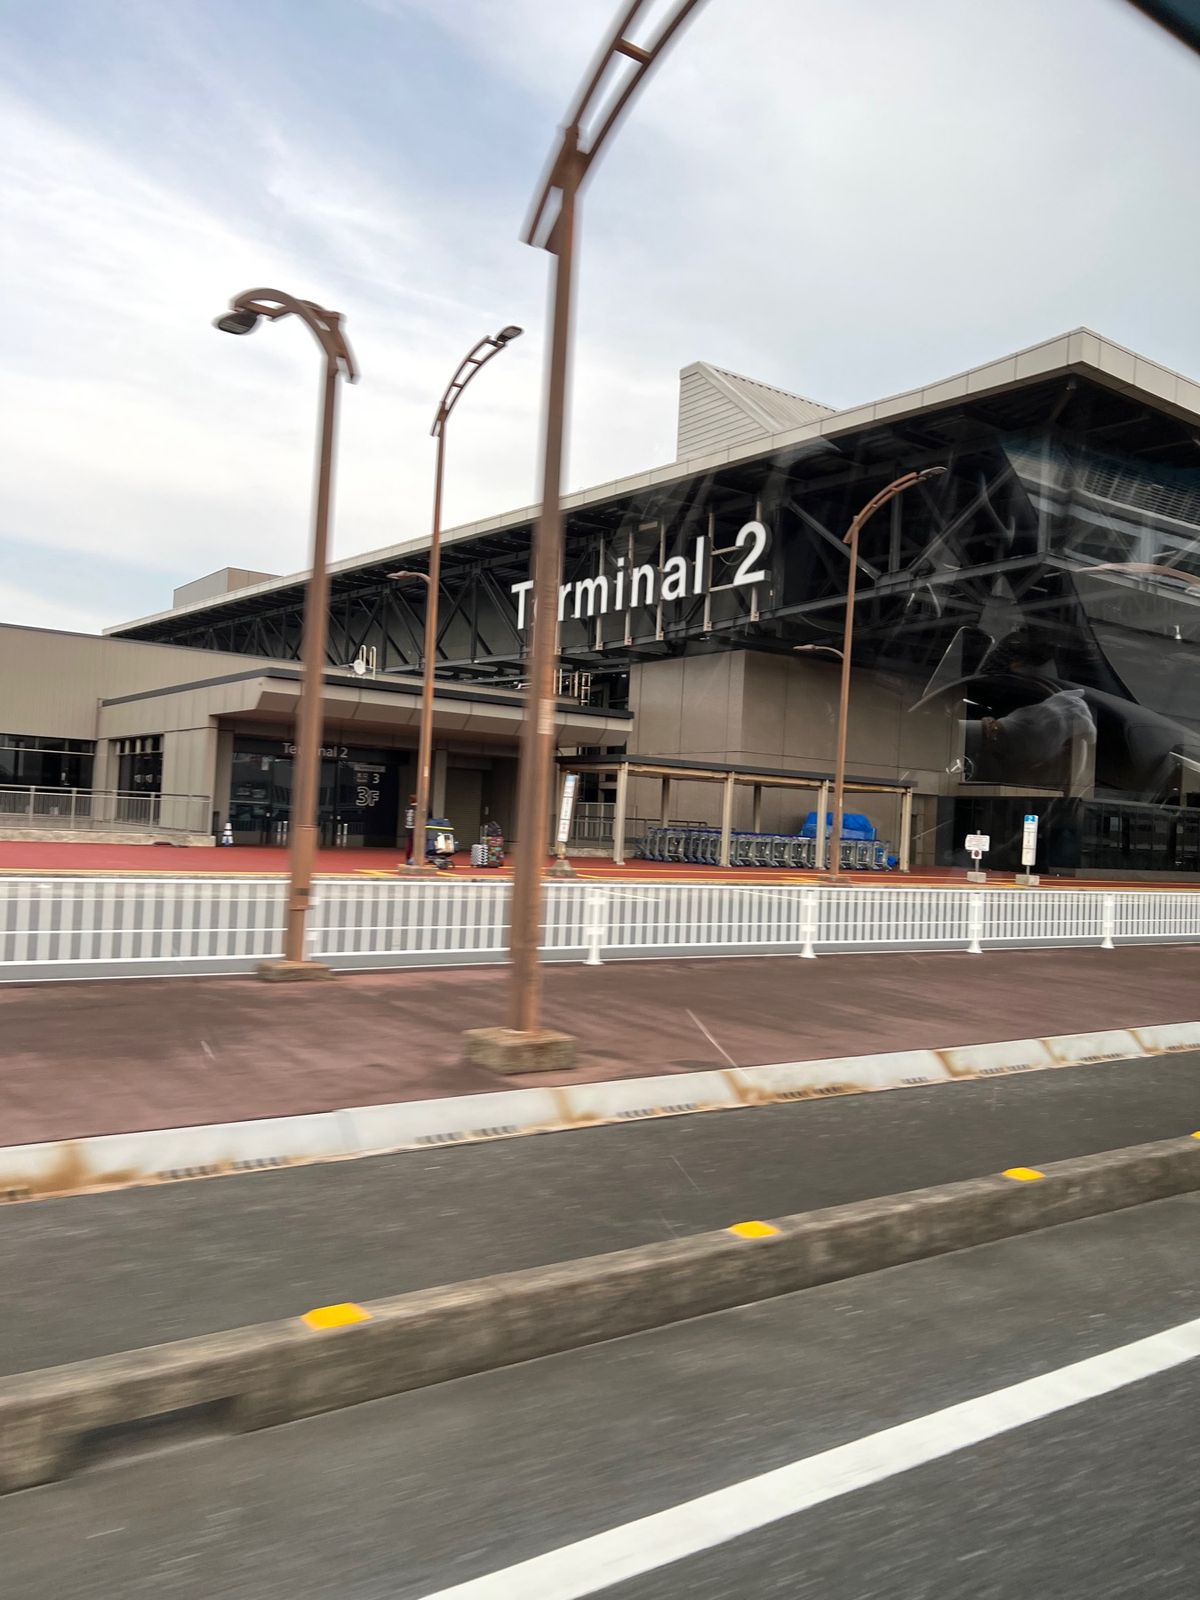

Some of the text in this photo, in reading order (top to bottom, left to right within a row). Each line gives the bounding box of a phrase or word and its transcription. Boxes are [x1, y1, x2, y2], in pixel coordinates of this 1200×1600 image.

[511, 521, 767, 630] Trminal 2
[282, 742, 349, 758] Tenal 2
[372, 773, 380, 783] 3
[355, 786, 380, 806] 3F
